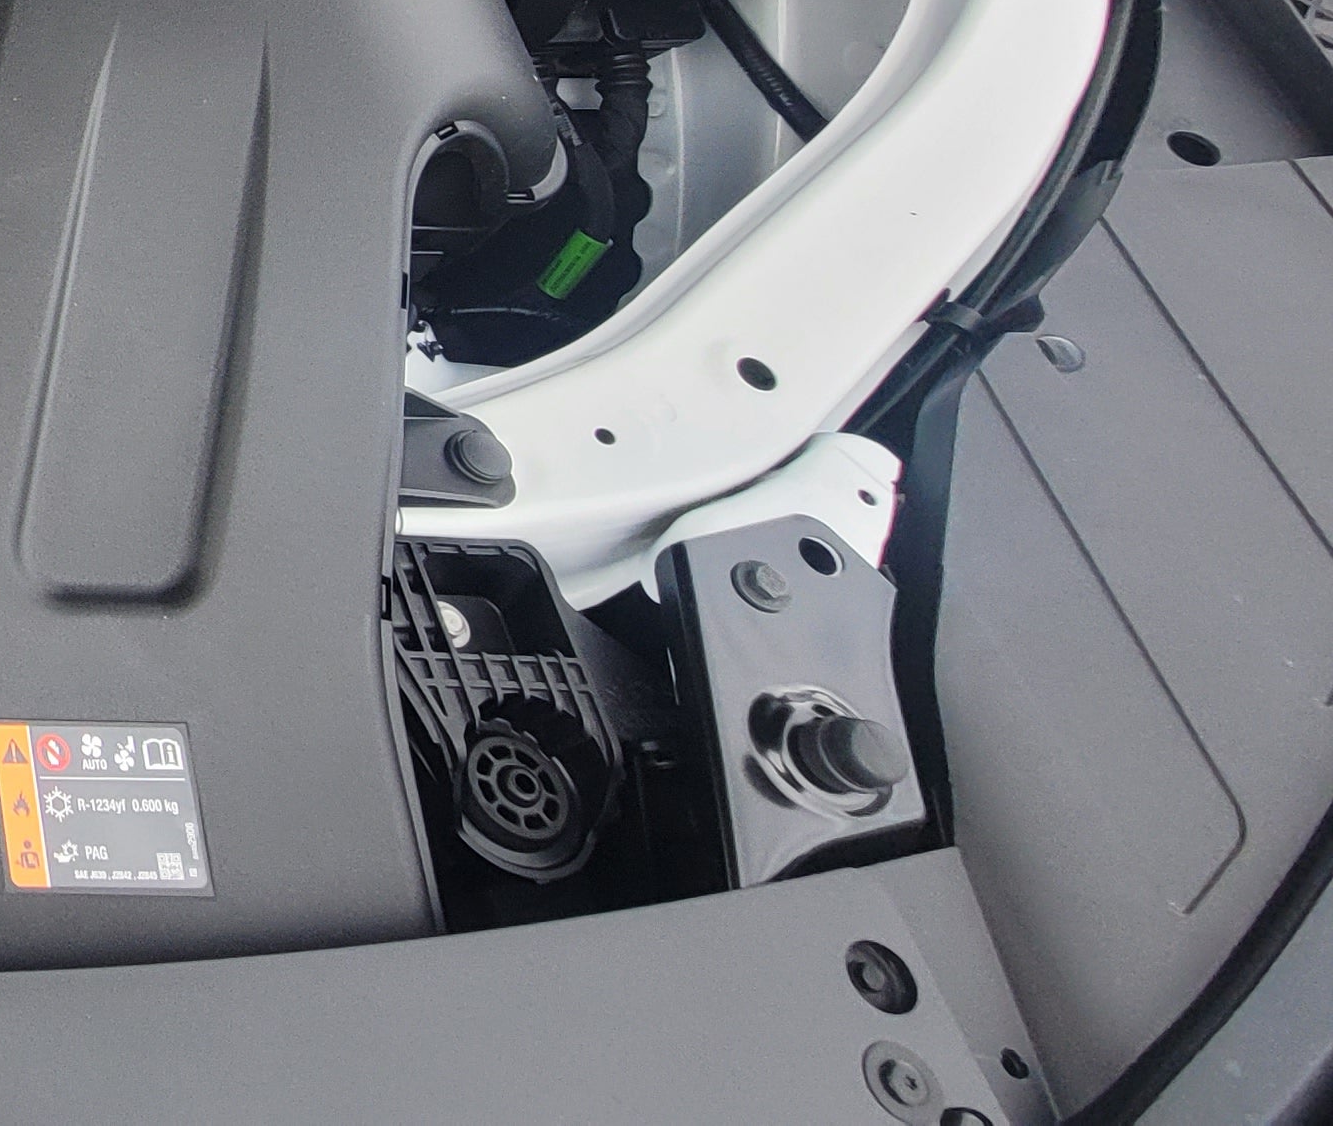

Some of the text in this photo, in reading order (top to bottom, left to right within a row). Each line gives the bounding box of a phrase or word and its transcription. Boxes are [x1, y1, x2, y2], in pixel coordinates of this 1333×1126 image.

[82, 759, 108, 771] AUTO
[77, 798, 179, 816] R-1234yf 0.600 kg
[85, 846, 109, 861] PAG
